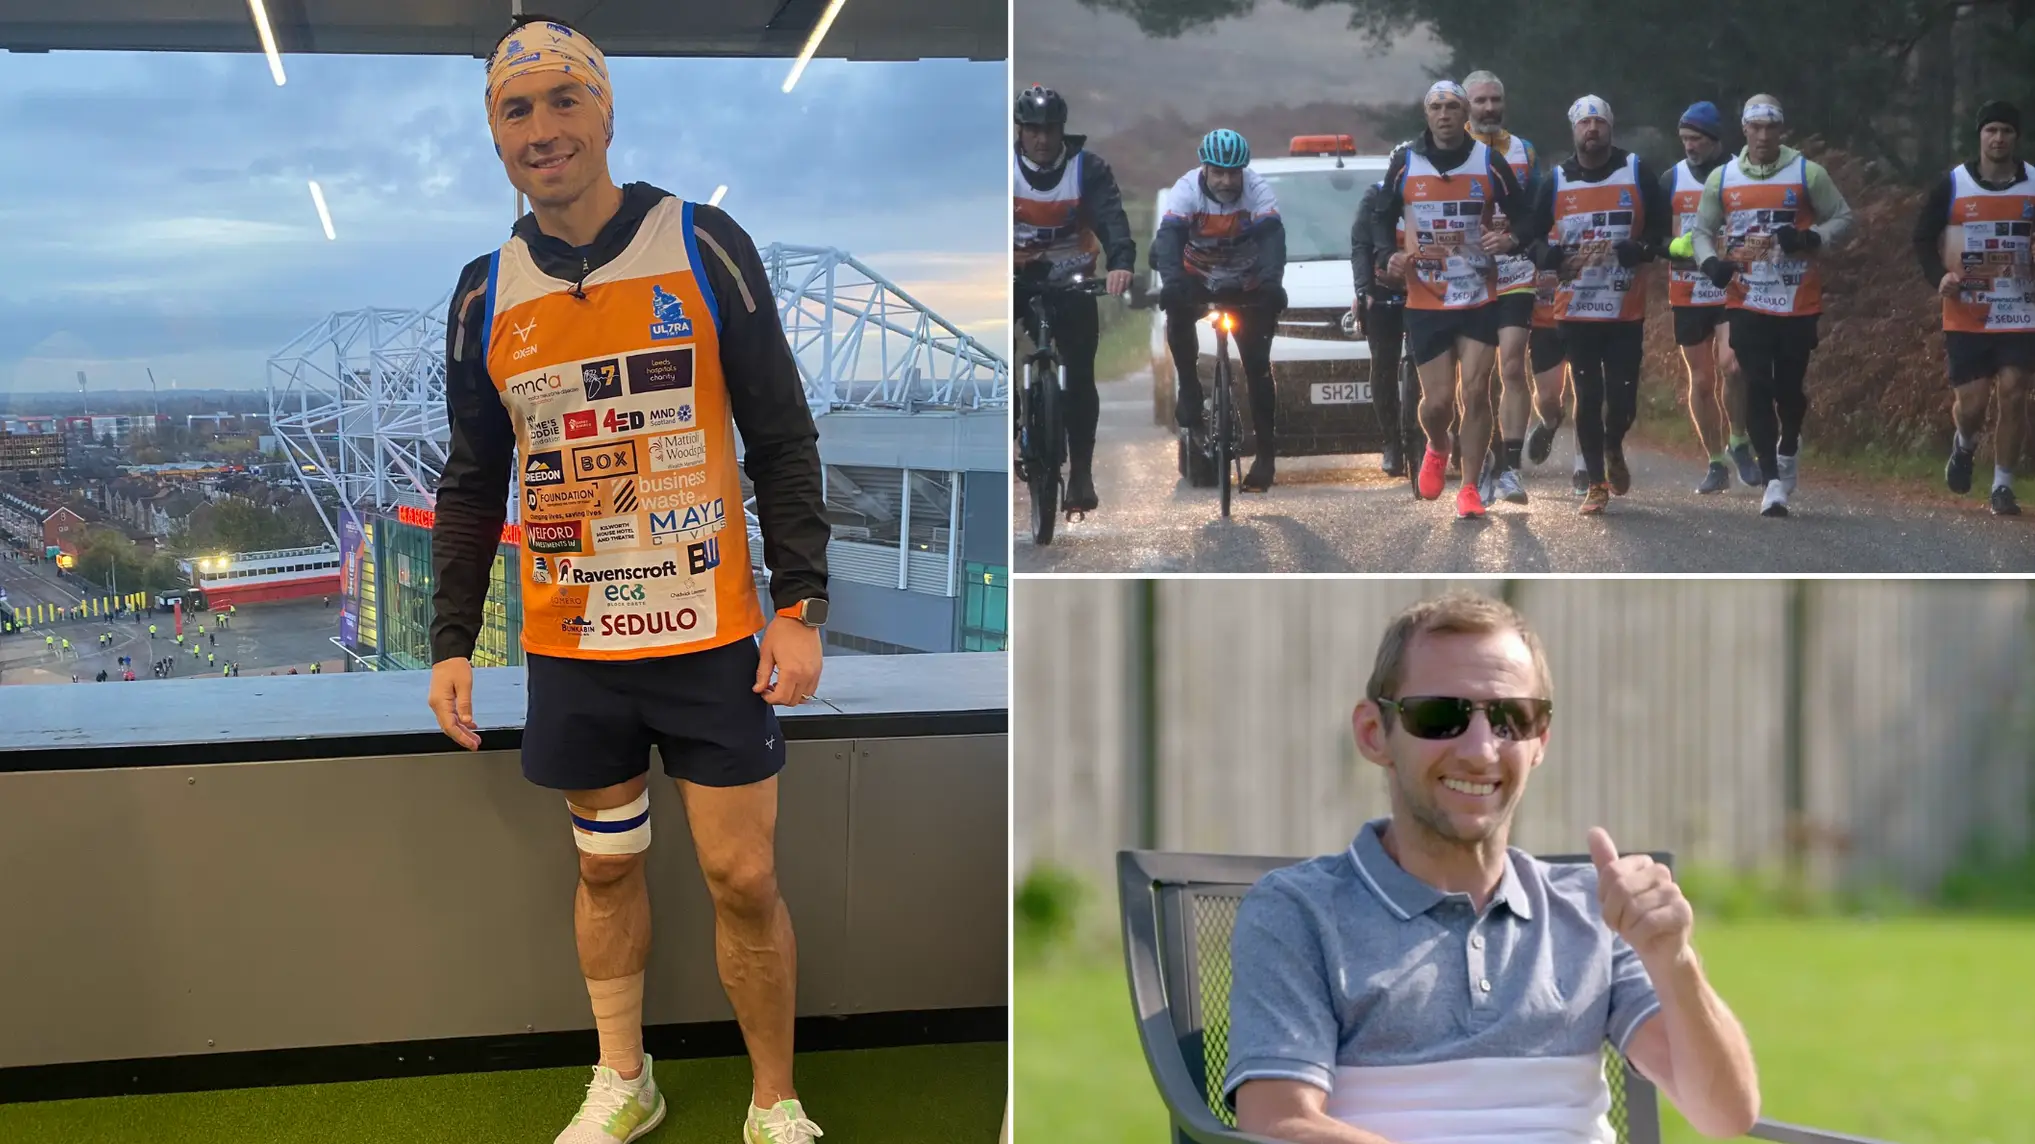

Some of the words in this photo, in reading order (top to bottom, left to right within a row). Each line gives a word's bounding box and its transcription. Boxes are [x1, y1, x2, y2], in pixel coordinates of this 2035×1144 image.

[1575, 302, 1613, 312] SEDULO
[1995, 314, 2031, 324] SEDULO
[653, 322, 690, 334] UL7RA
[513, 344, 538, 360] OXEN
[650, 374, 676, 382] charity
[650, 408, 676, 420] MND
[650, 418, 676, 426] Scotland
[581, 450, 628, 471] BOX
[638, 470, 706, 493] business
[540, 489, 594, 502] FOUNDATION
[641, 491, 695, 511] waste
[649, 497, 724, 533] MAYO
[600, 522, 630, 531] KILWORTH
[652, 520, 727, 546] CIVILS
[526, 524, 574, 546] WELFORD
[610, 534, 635, 542] THEATRE
[573, 560, 677, 583] Ravenscroft
[600, 608, 697, 636] SEDULO
